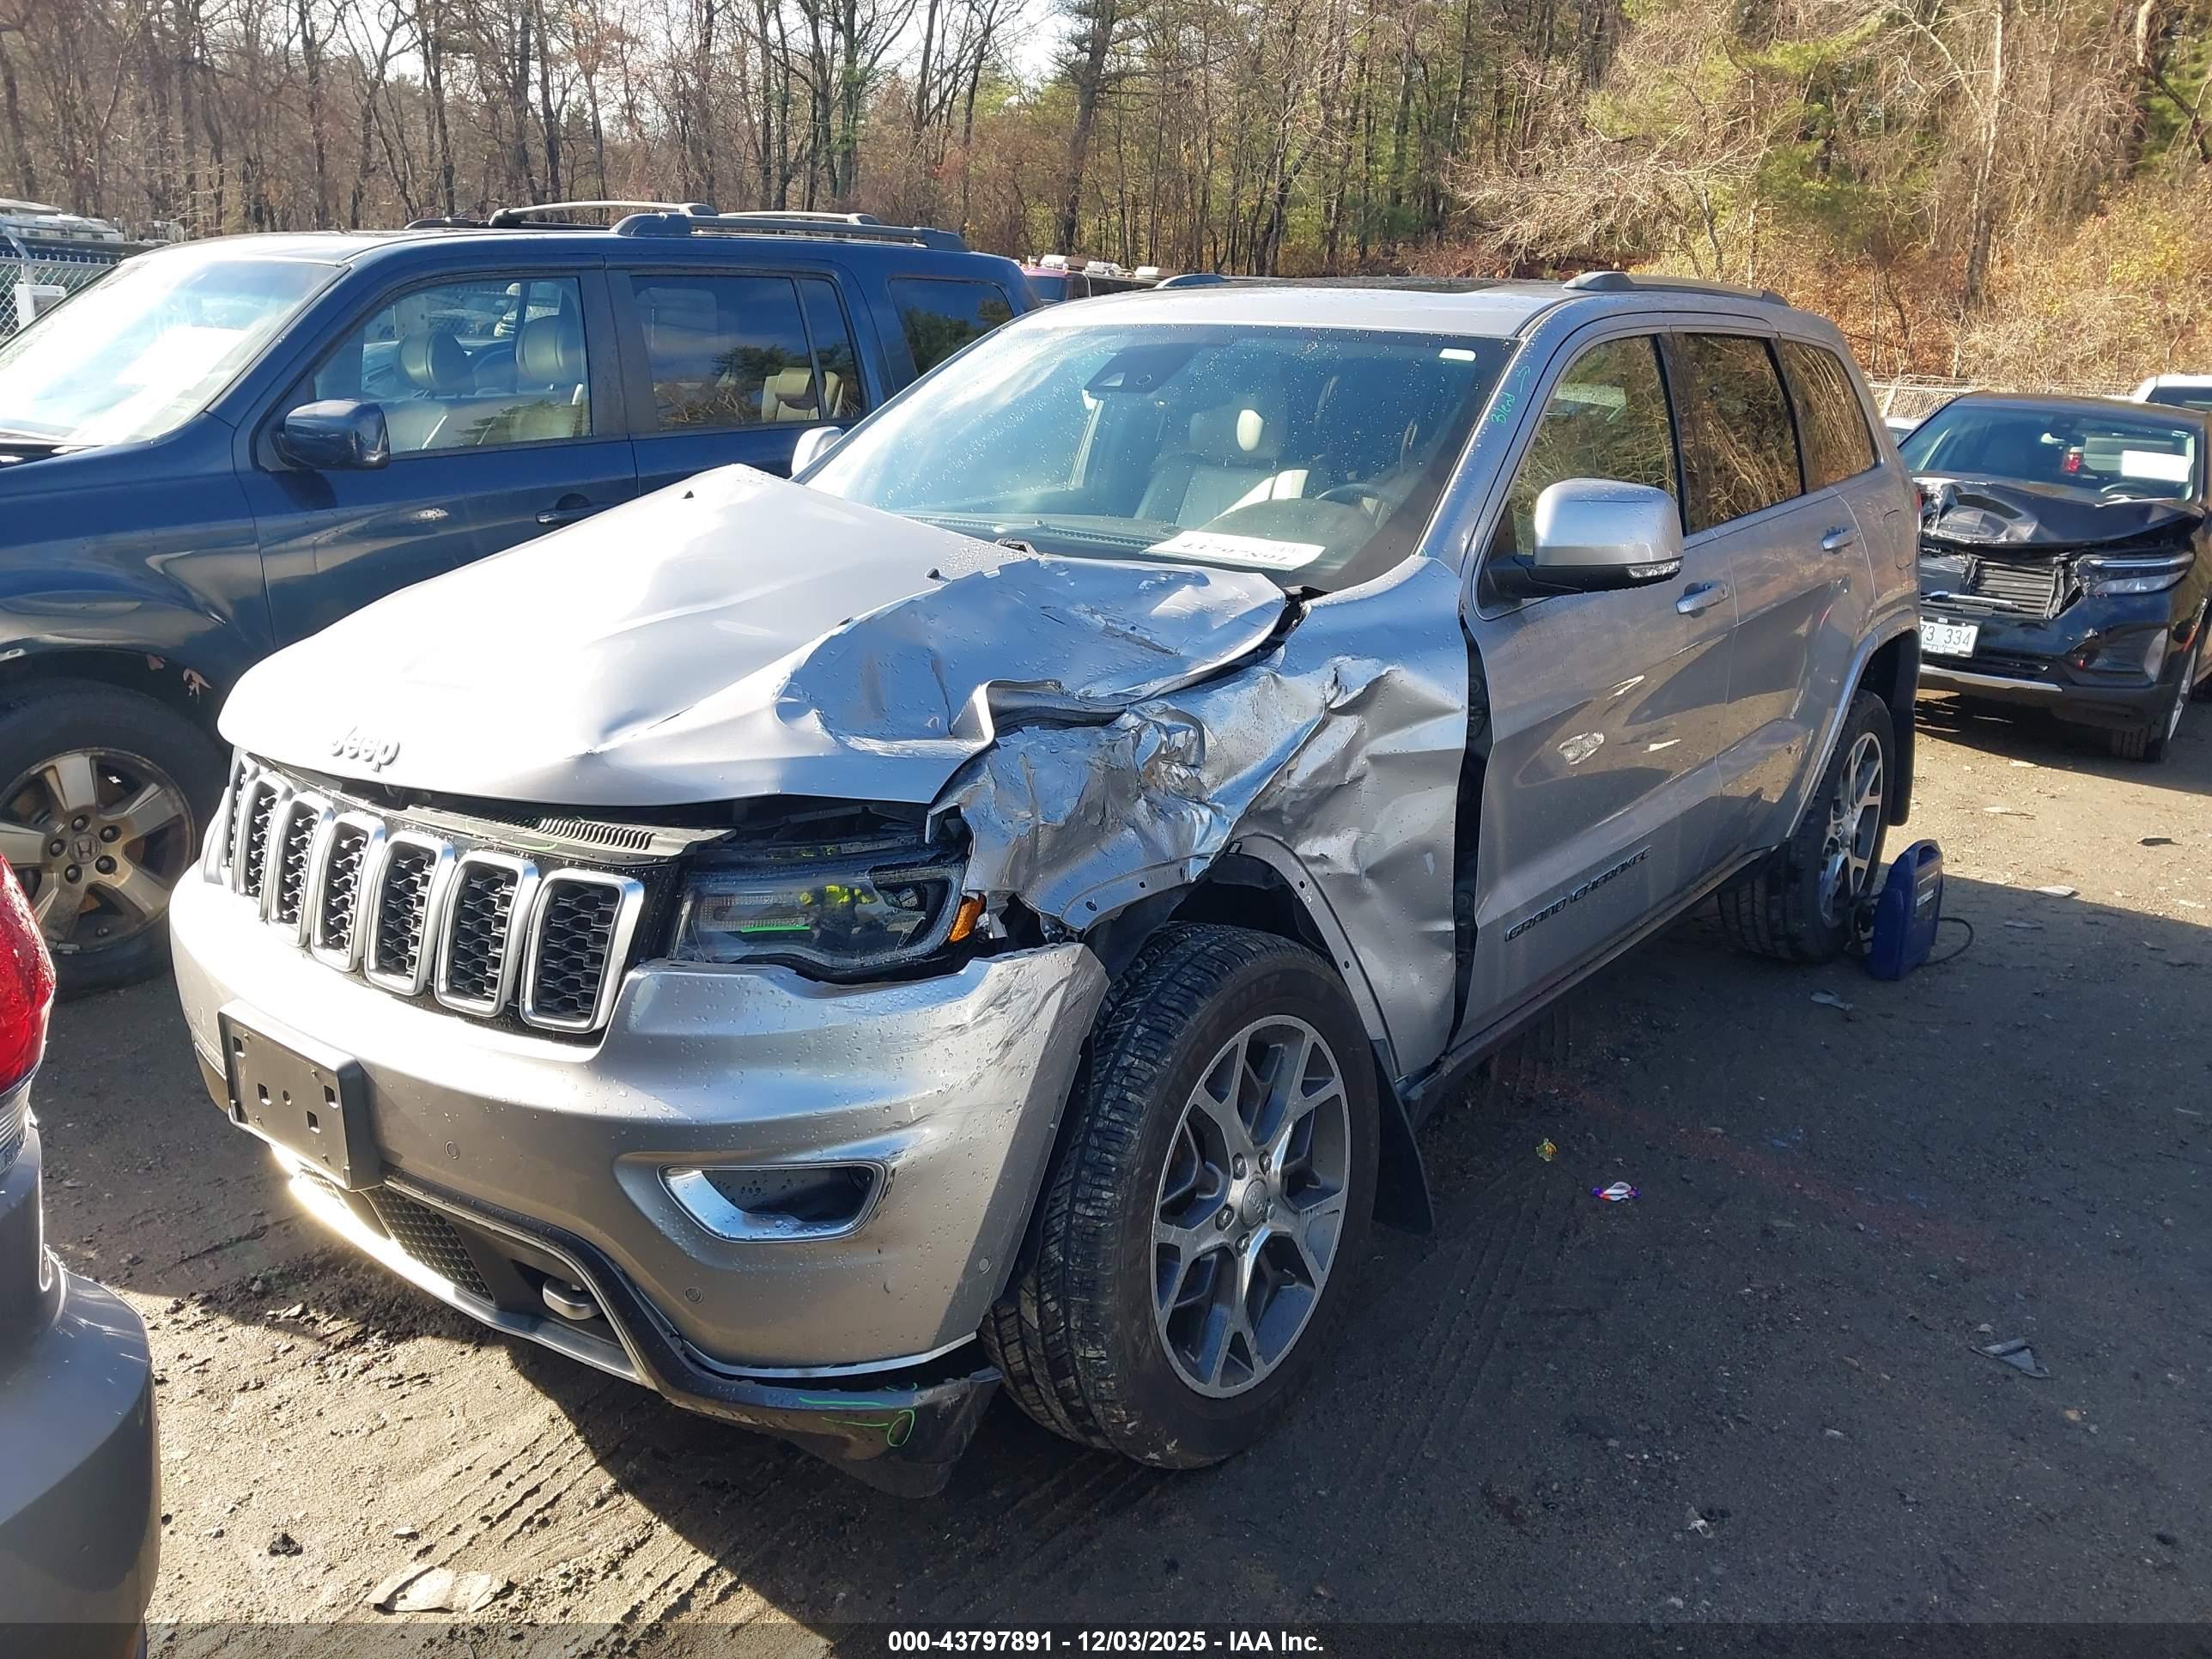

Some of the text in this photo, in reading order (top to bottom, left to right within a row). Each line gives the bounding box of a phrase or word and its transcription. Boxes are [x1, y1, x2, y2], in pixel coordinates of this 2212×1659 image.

[1491, 392, 1516, 426] Blend
[1944, 628, 1972, 647] 334
[330, 725, 401, 773] Jeep
[1504, 845, 1651, 942] GRAND CHEROKEE
